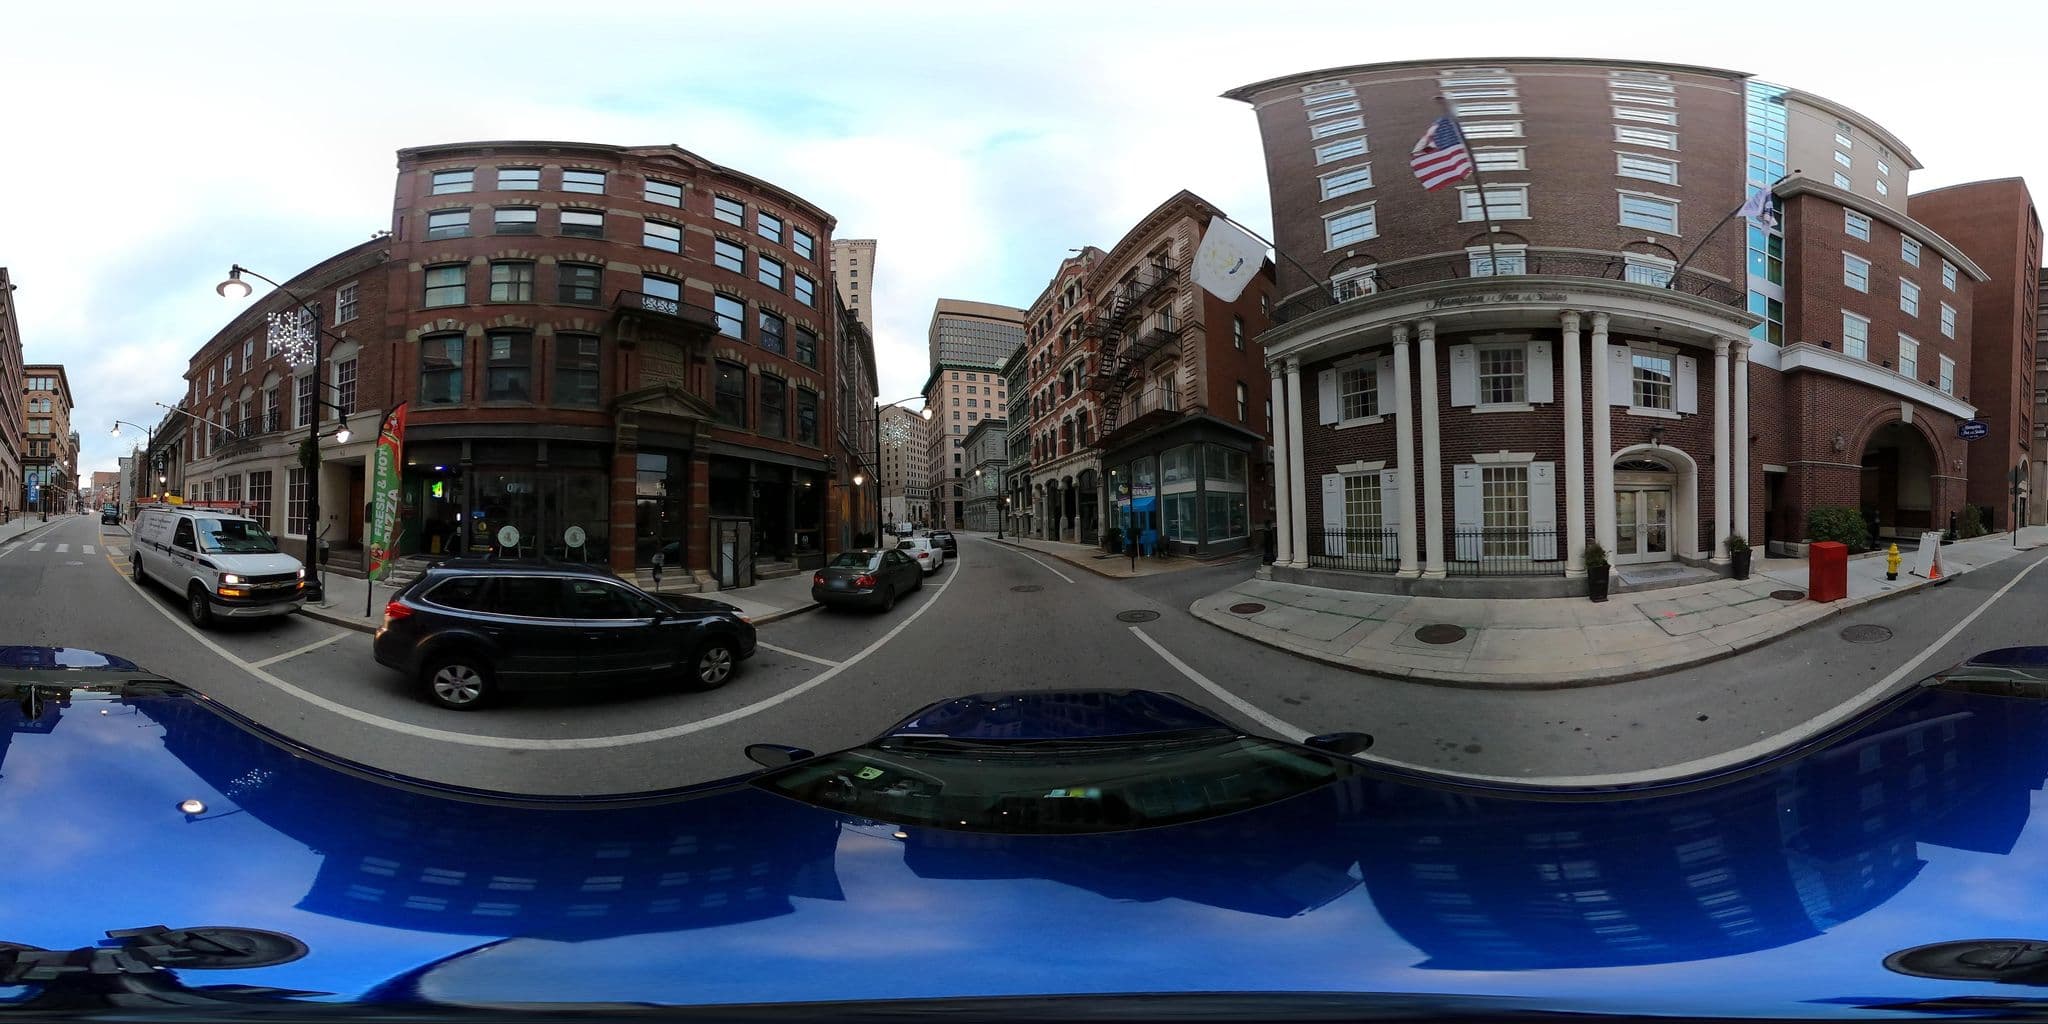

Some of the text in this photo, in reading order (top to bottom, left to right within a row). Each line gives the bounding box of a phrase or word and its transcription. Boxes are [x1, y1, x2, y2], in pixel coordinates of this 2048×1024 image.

[1426, 294, 1484, 309] Hampton
[1495, 290, 1519, 302] Inn
[376, 479, 387, 489] &
[374, 491, 386, 537] FRESH
[383, 488, 399, 544] PIZZA
